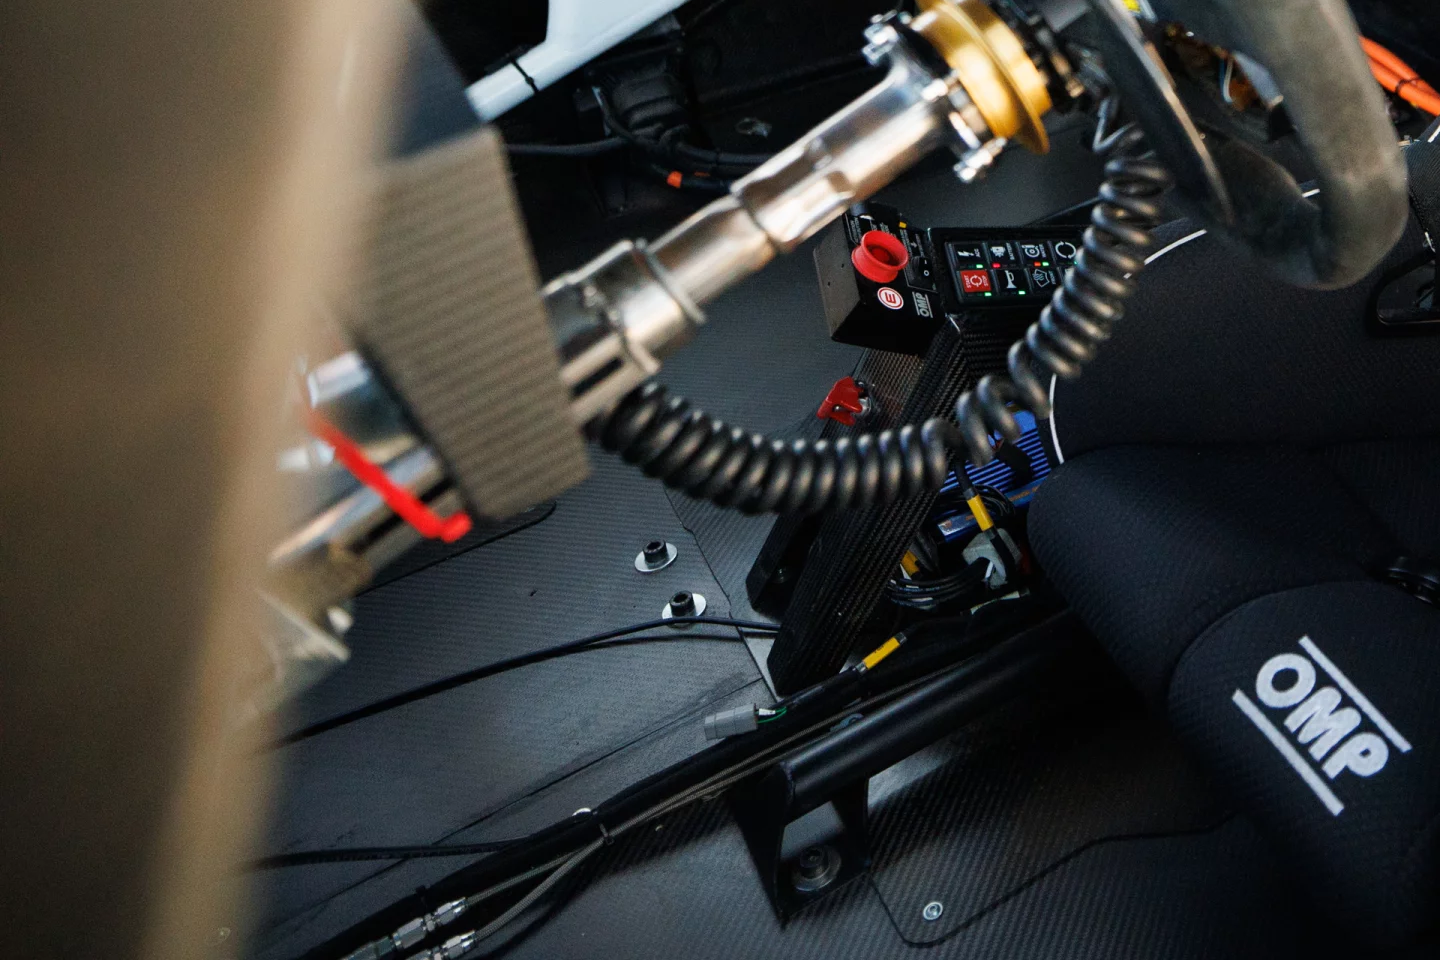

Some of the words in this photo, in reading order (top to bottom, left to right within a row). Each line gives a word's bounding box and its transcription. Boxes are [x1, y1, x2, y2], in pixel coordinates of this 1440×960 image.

[963, 274, 972, 289] START
[981, 274, 989, 287] STOP
[915, 292, 930, 318] OMP
[1255, 652, 1390, 780] OMP
